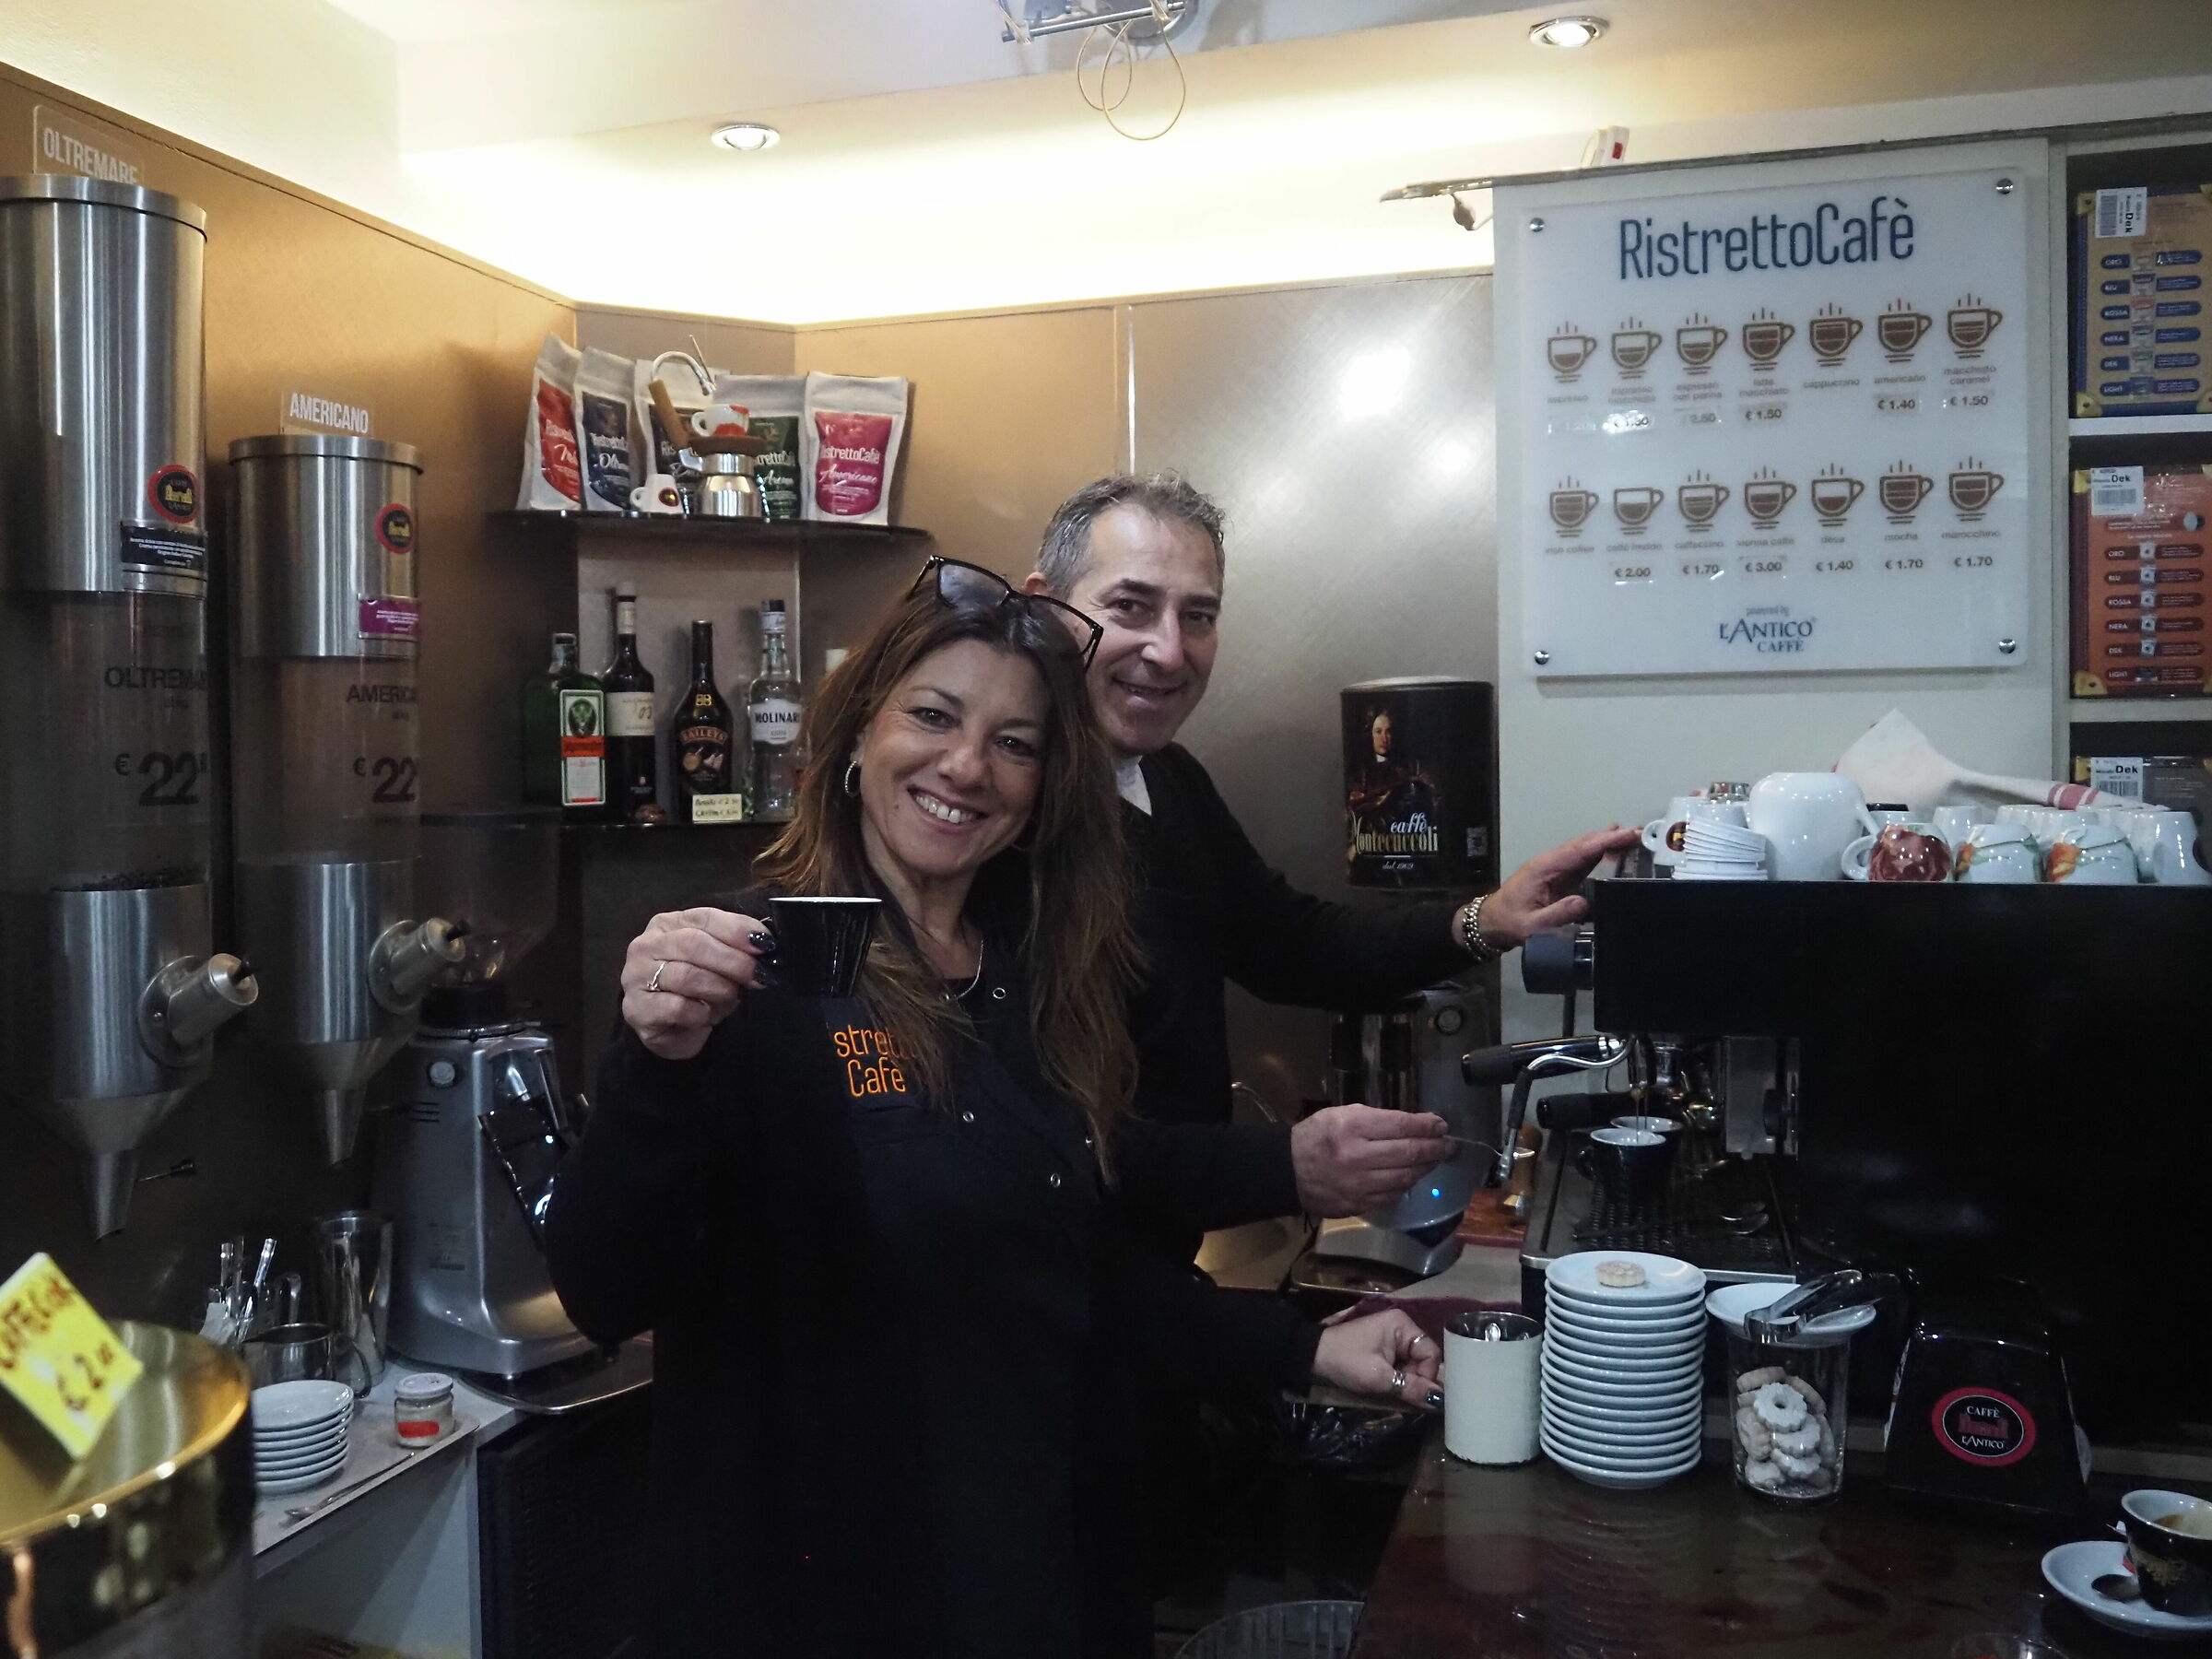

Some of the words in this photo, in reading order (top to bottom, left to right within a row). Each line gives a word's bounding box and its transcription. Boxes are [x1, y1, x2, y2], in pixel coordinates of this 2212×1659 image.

[1619, 196, 1915, 280] RistrettoCafè
[1874, 374, 1926, 384] americano
[1739, 387, 1789, 397] macchiato
[1877, 400, 1885, 410] €
[1888, 399, 1916, 409] 1.40
[289, 393, 369, 434] AMERICANO
[2111, 474, 2131, 483] Dek
[1941, 530, 2001, 539] marocchino
[1746, 562, 1752, 572] €
[1756, 562, 1783, 572] 3.00
[1816, 561, 1823, 571] €
[1828, 560, 1853, 571] 1.40
[1885, 559, 1892, 570] €
[1897, 559, 1924, 569] 1.70
[1954, 558, 1961, 567] €
[1966, 556, 1993, 567] 1.70
[1615, 568, 1622, 578] €
[1625, 568, 1651, 578] 2.00
[1682, 565, 1689, 575] €
[1694, 564, 1720, 575] 1.70
[114, 752, 131, 777] €
[353, 756, 367, 778] €
[2115, 764, 2138, 774] Dek
